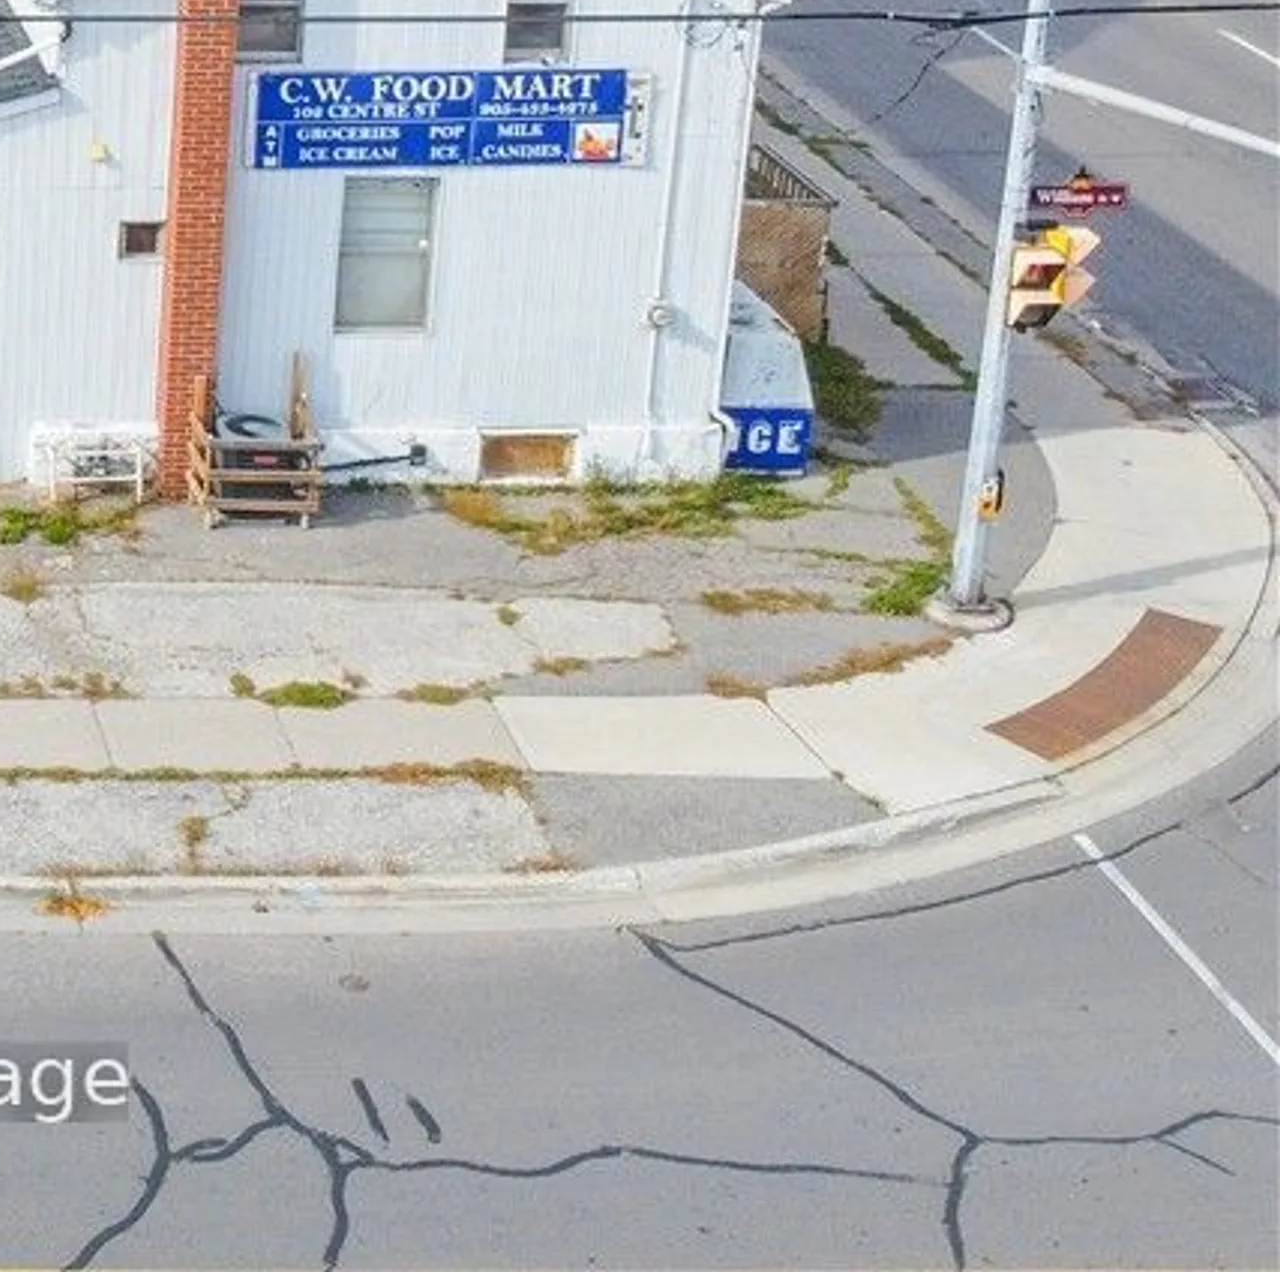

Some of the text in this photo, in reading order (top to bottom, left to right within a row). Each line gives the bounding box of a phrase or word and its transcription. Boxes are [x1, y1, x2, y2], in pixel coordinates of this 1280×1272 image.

[279, 74, 600, 103] C.W. FOOD MART
[327, 103, 411, 119] CENTRE
[414, 102, 442, 118] ST
[296, 124, 544, 141] GROCERIES POP MILK
[263, 126, 277, 166] ATM
[298, 144, 563, 162] ICE CREAM ICE CANDIES
